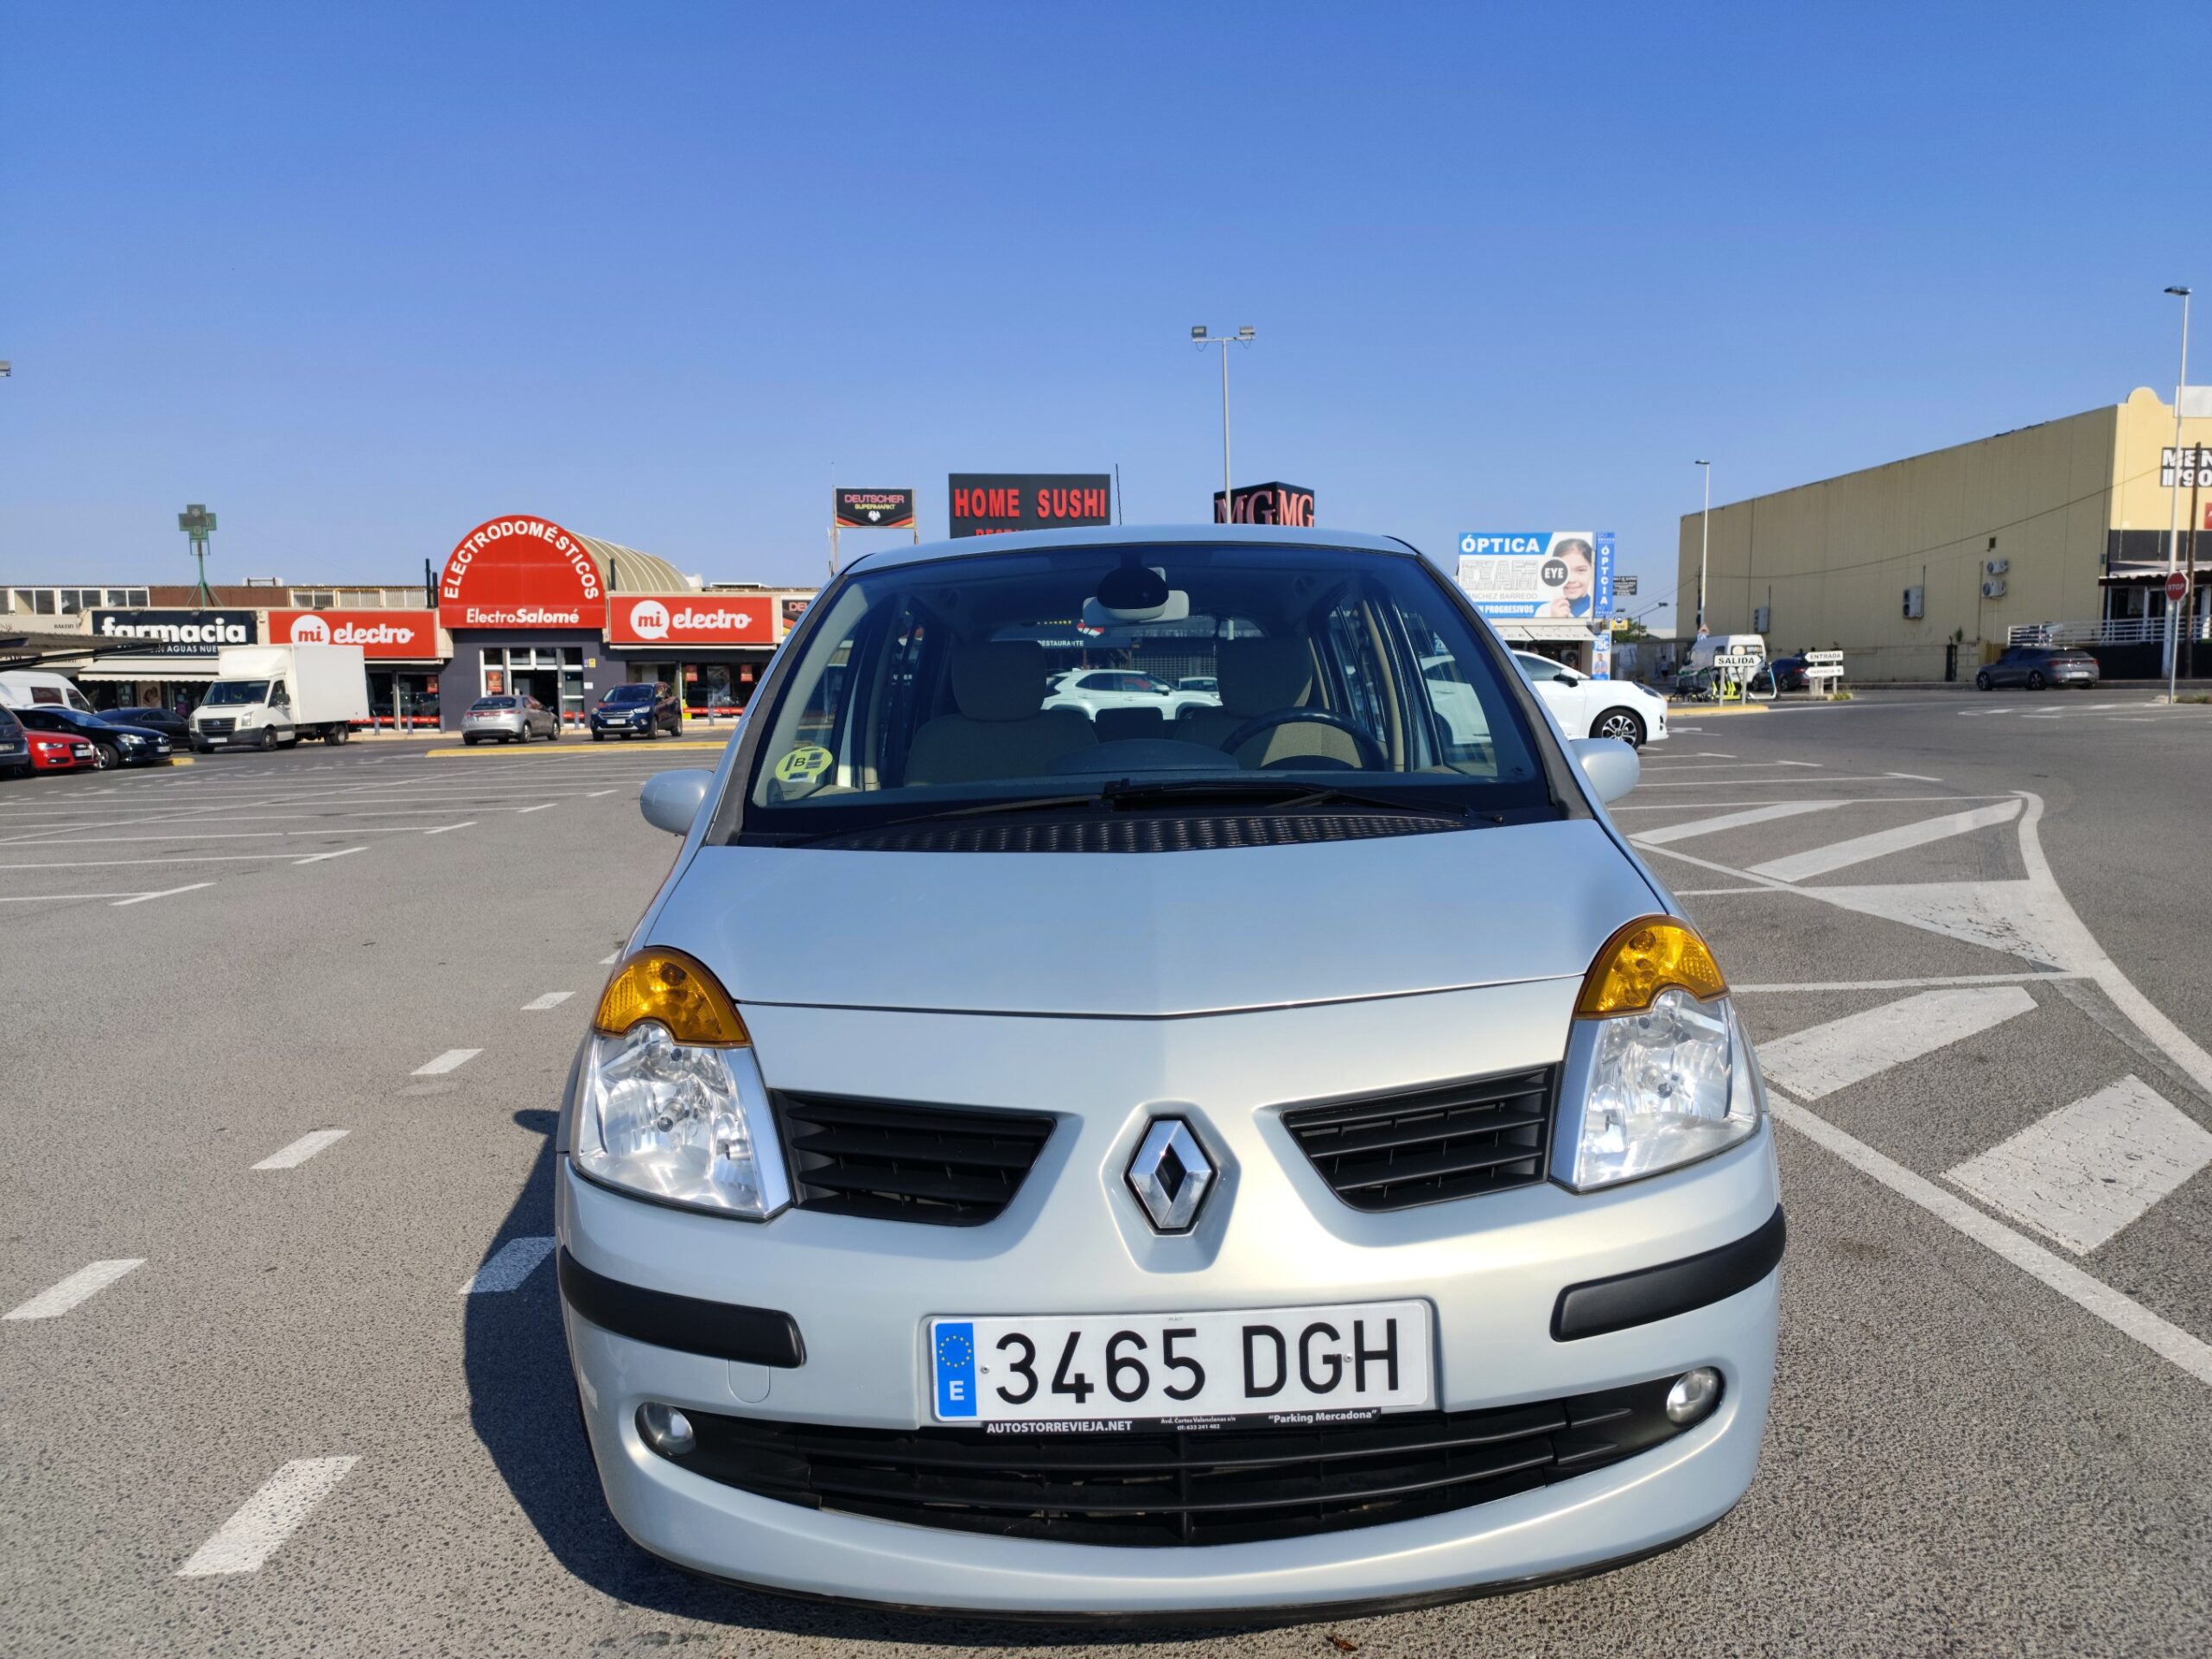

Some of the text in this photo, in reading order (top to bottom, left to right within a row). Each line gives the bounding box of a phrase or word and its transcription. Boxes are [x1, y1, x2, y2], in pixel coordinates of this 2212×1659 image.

[844, 494, 905, 504] DEUTSCHER
[954, 488, 1106, 518] HOME SUSHI
[1461, 534, 1540, 553] ÓPTICA
[444, 520, 599, 600] ELECTRODOMÉSTICOS
[1544, 568, 1564, 579] EYE
[467, 608, 580, 623] ElectroSalomé
[638, 607, 753, 629] mi electro
[1484, 604, 1535, 614] PROGRESIVOS
[102, 616, 246, 643] farmacia
[298, 622, 415, 644] mi electro
[794, 757, 806, 767] B
[995, 1318, 1400, 1405] 3465 DGH
[950, 1380, 964, 1402] E
[987, 1420, 1133, 1434] AUTOSTORREVIEJA.NET
